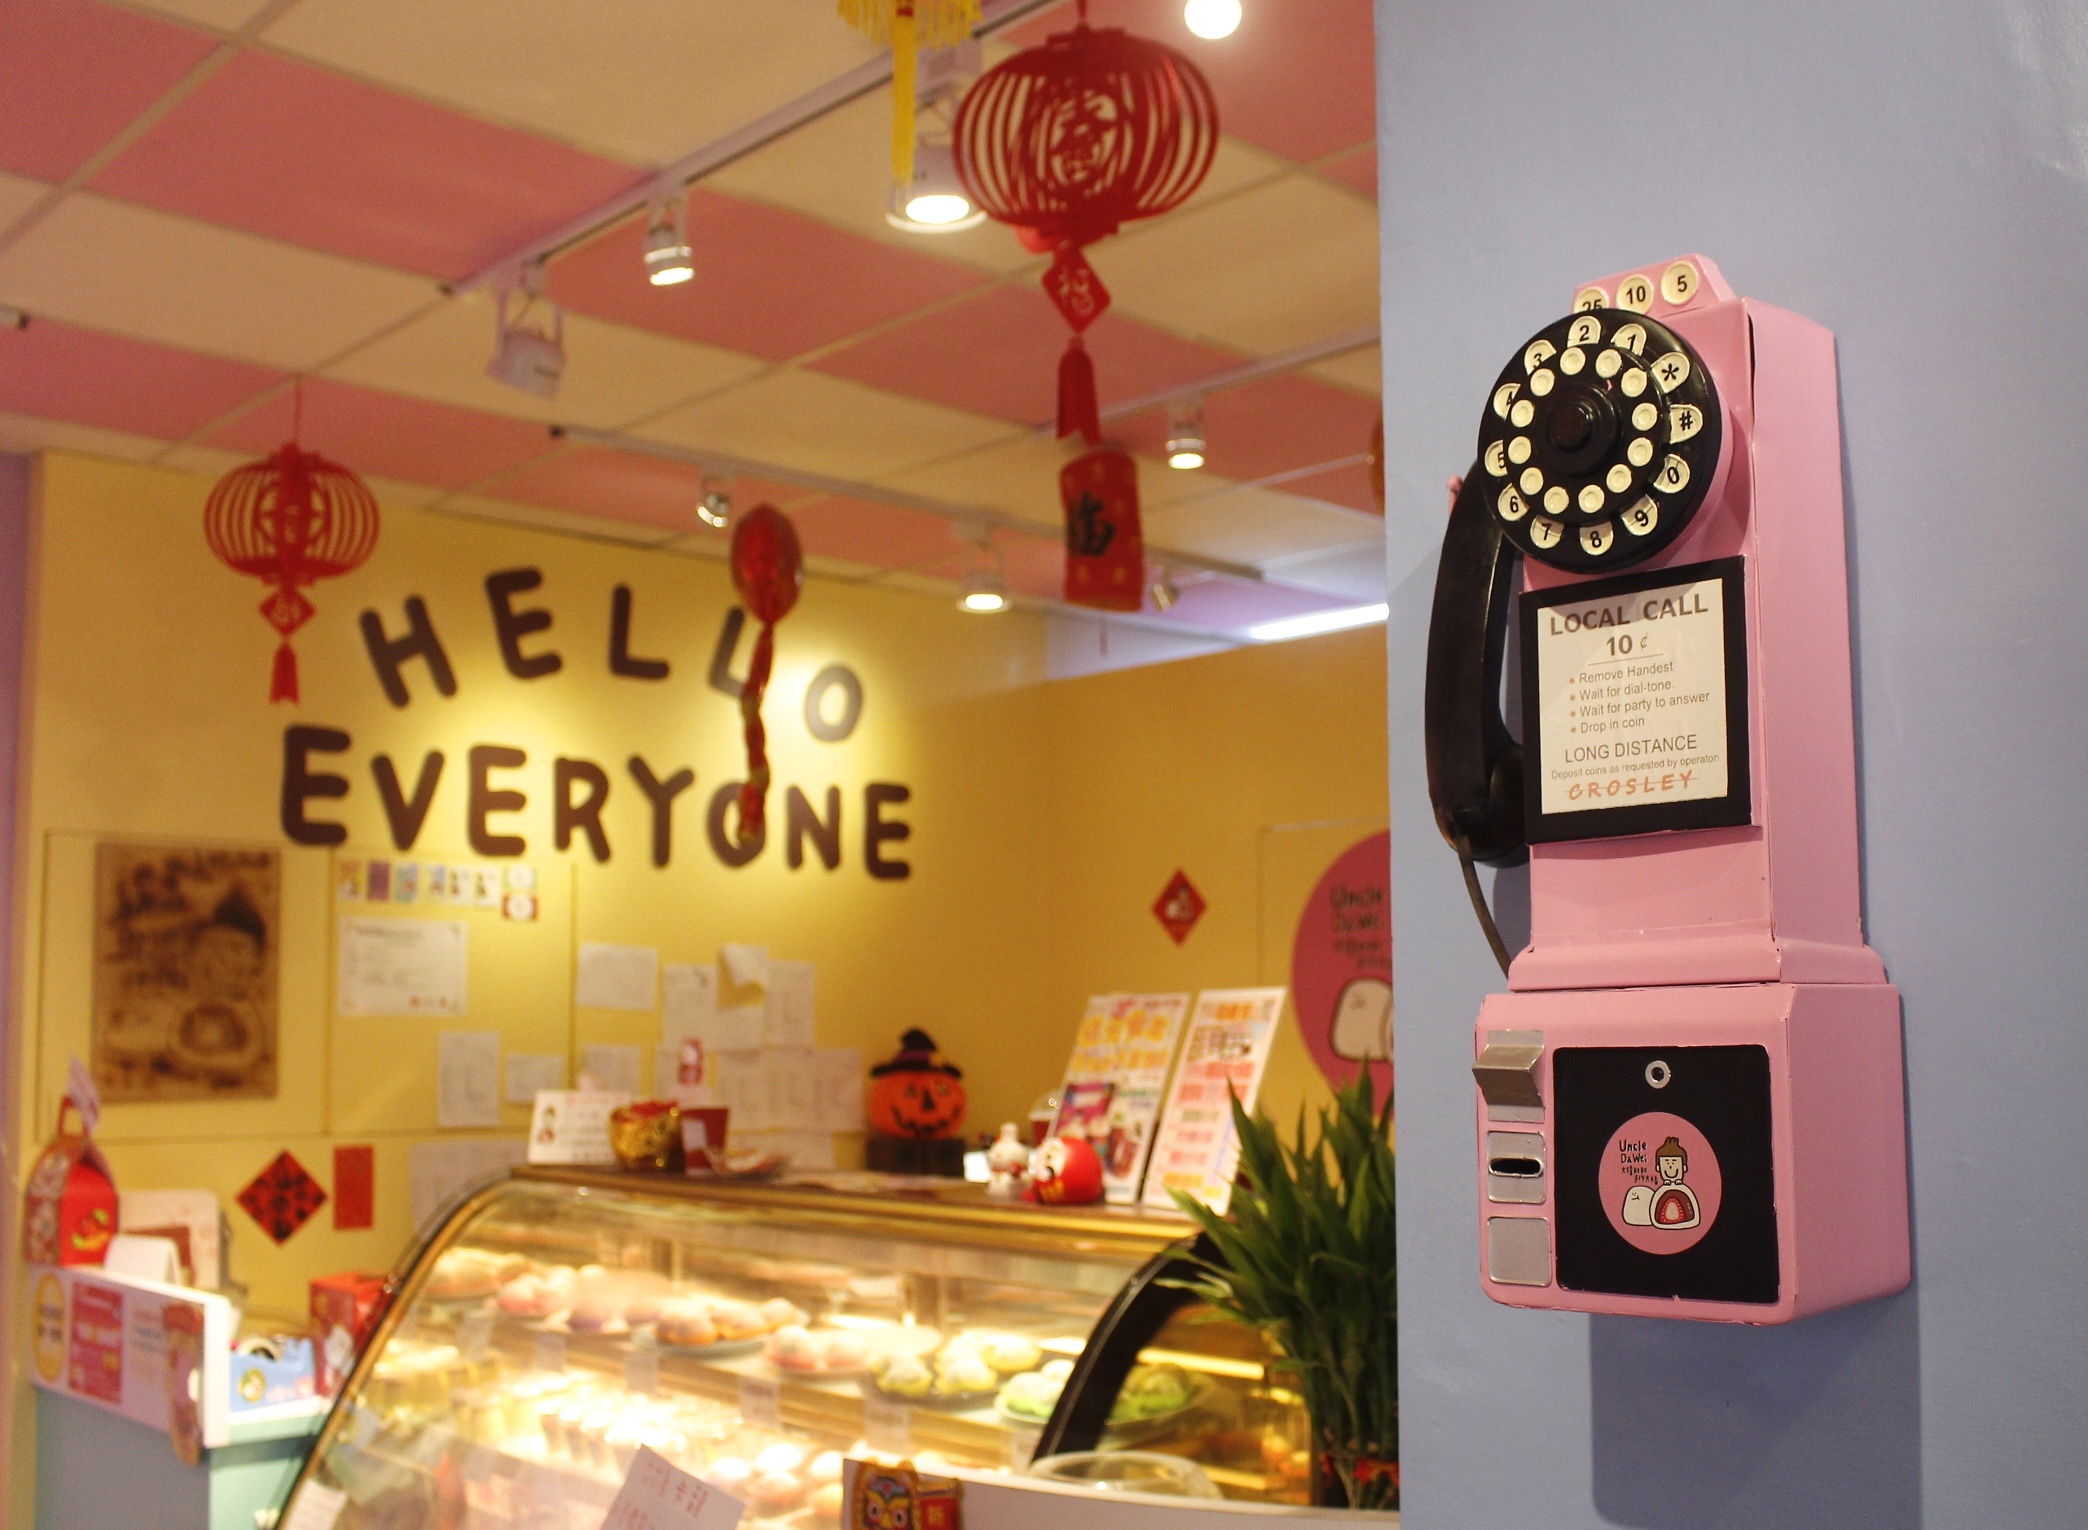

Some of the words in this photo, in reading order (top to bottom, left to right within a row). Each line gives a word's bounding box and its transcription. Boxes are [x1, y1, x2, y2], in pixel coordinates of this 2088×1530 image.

[1626, 286, 1646, 304] 10
[1677, 275, 1687, 292] 5
[1579, 325, 1589, 341] 2
[1627, 334, 1636, 351] 1
[1533, 353, 1542, 368] 3
[1667, 467, 1679, 484] 0
[1510, 496, 1518, 513] 6
[1635, 510, 1648, 527] 9
[1542, 523, 1551, 540] 7
[1590, 531, 1602, 548] 8
[1550, 606, 1630, 636] LOCAL
[1643, 594, 1708, 621] CALL
[359, 566, 863, 742] HELLO
[1606, 634, 1633, 656] 10
[1579, 669, 1623, 684] Remove
[1627, 662, 1673, 677] Handest
[1579, 688, 1604, 701] Wait
[1607, 686, 1620, 697] for
[1580, 704, 1604, 717] Wait
[1607, 702, 1621, 714] for
[1625, 699, 1652, 713] party
[1655, 698, 1666, 708] to
[1669, 692, 1710, 706] answer
[1581, 721, 1606, 734] Drop
[1609, 718, 1619, 730] in
[1622, 716, 1645, 728] coin
[1565, 745, 1610, 763] LONG
[1615, 734, 1697, 758] DISTANCE
[1551, 768, 1583, 780] Deposit
[1585, 767, 1607, 776] coins
[1623, 761, 1664, 773] requested
[1667, 758, 1677, 768] by
[1568, 769, 1693, 800] CROSLEY
[279, 722, 912, 880] EVERYONE
[1619, 1140, 1647, 1152] Uncle
